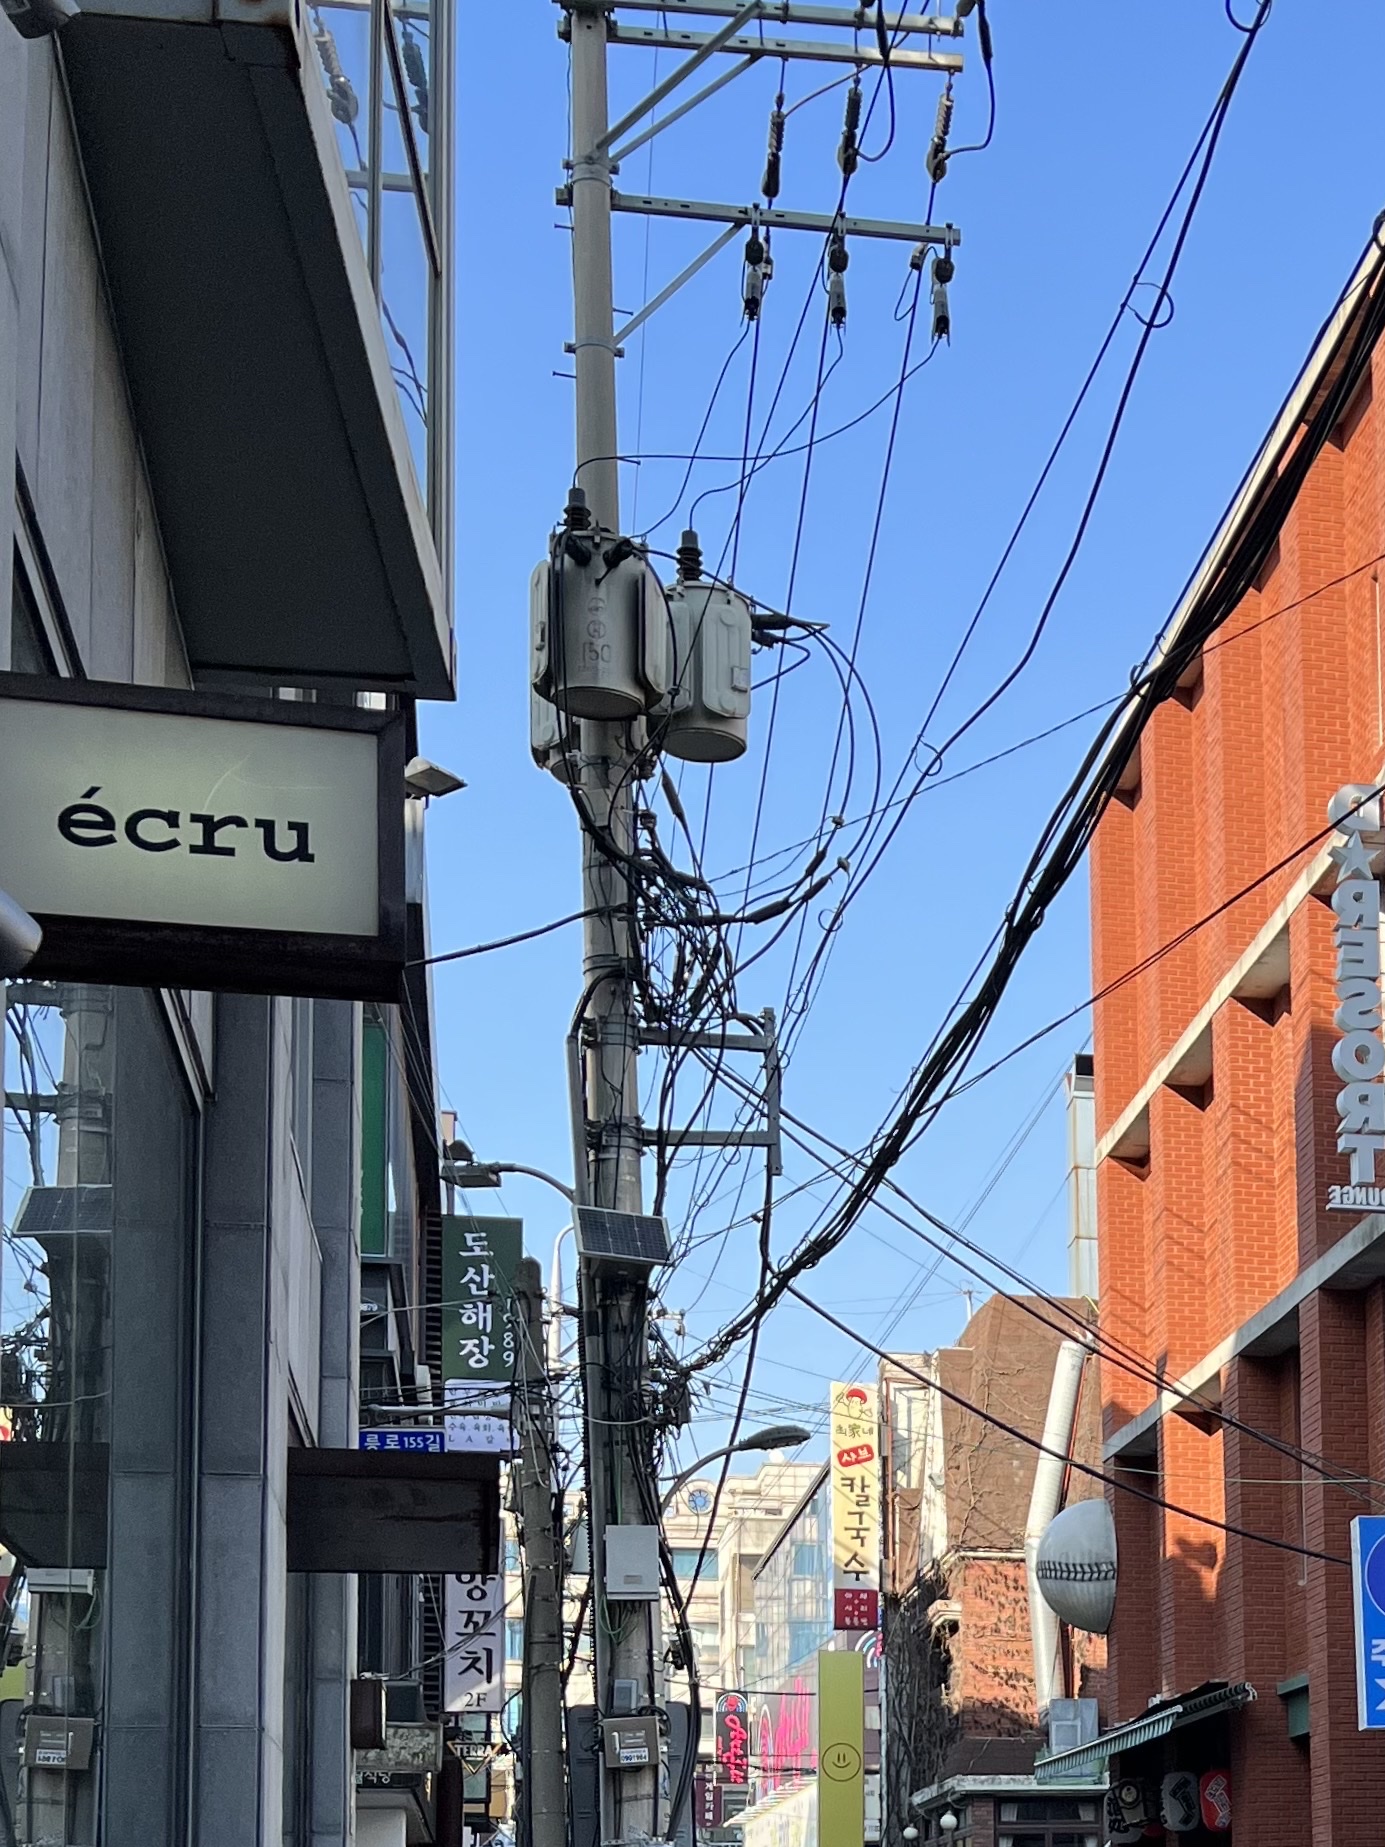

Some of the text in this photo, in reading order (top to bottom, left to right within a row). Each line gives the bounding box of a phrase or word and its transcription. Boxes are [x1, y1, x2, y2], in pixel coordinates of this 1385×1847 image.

[58, 786, 315, 863] écru
[458, 1232, 496, 1369] 도산해장
[841, 1475, 872, 1581] 칼국수
[455, 1573, 497, 1684] 양꼬치
[464, 1692, 487, 1707] 2F
[455, 1743, 493, 1758] TERRA
